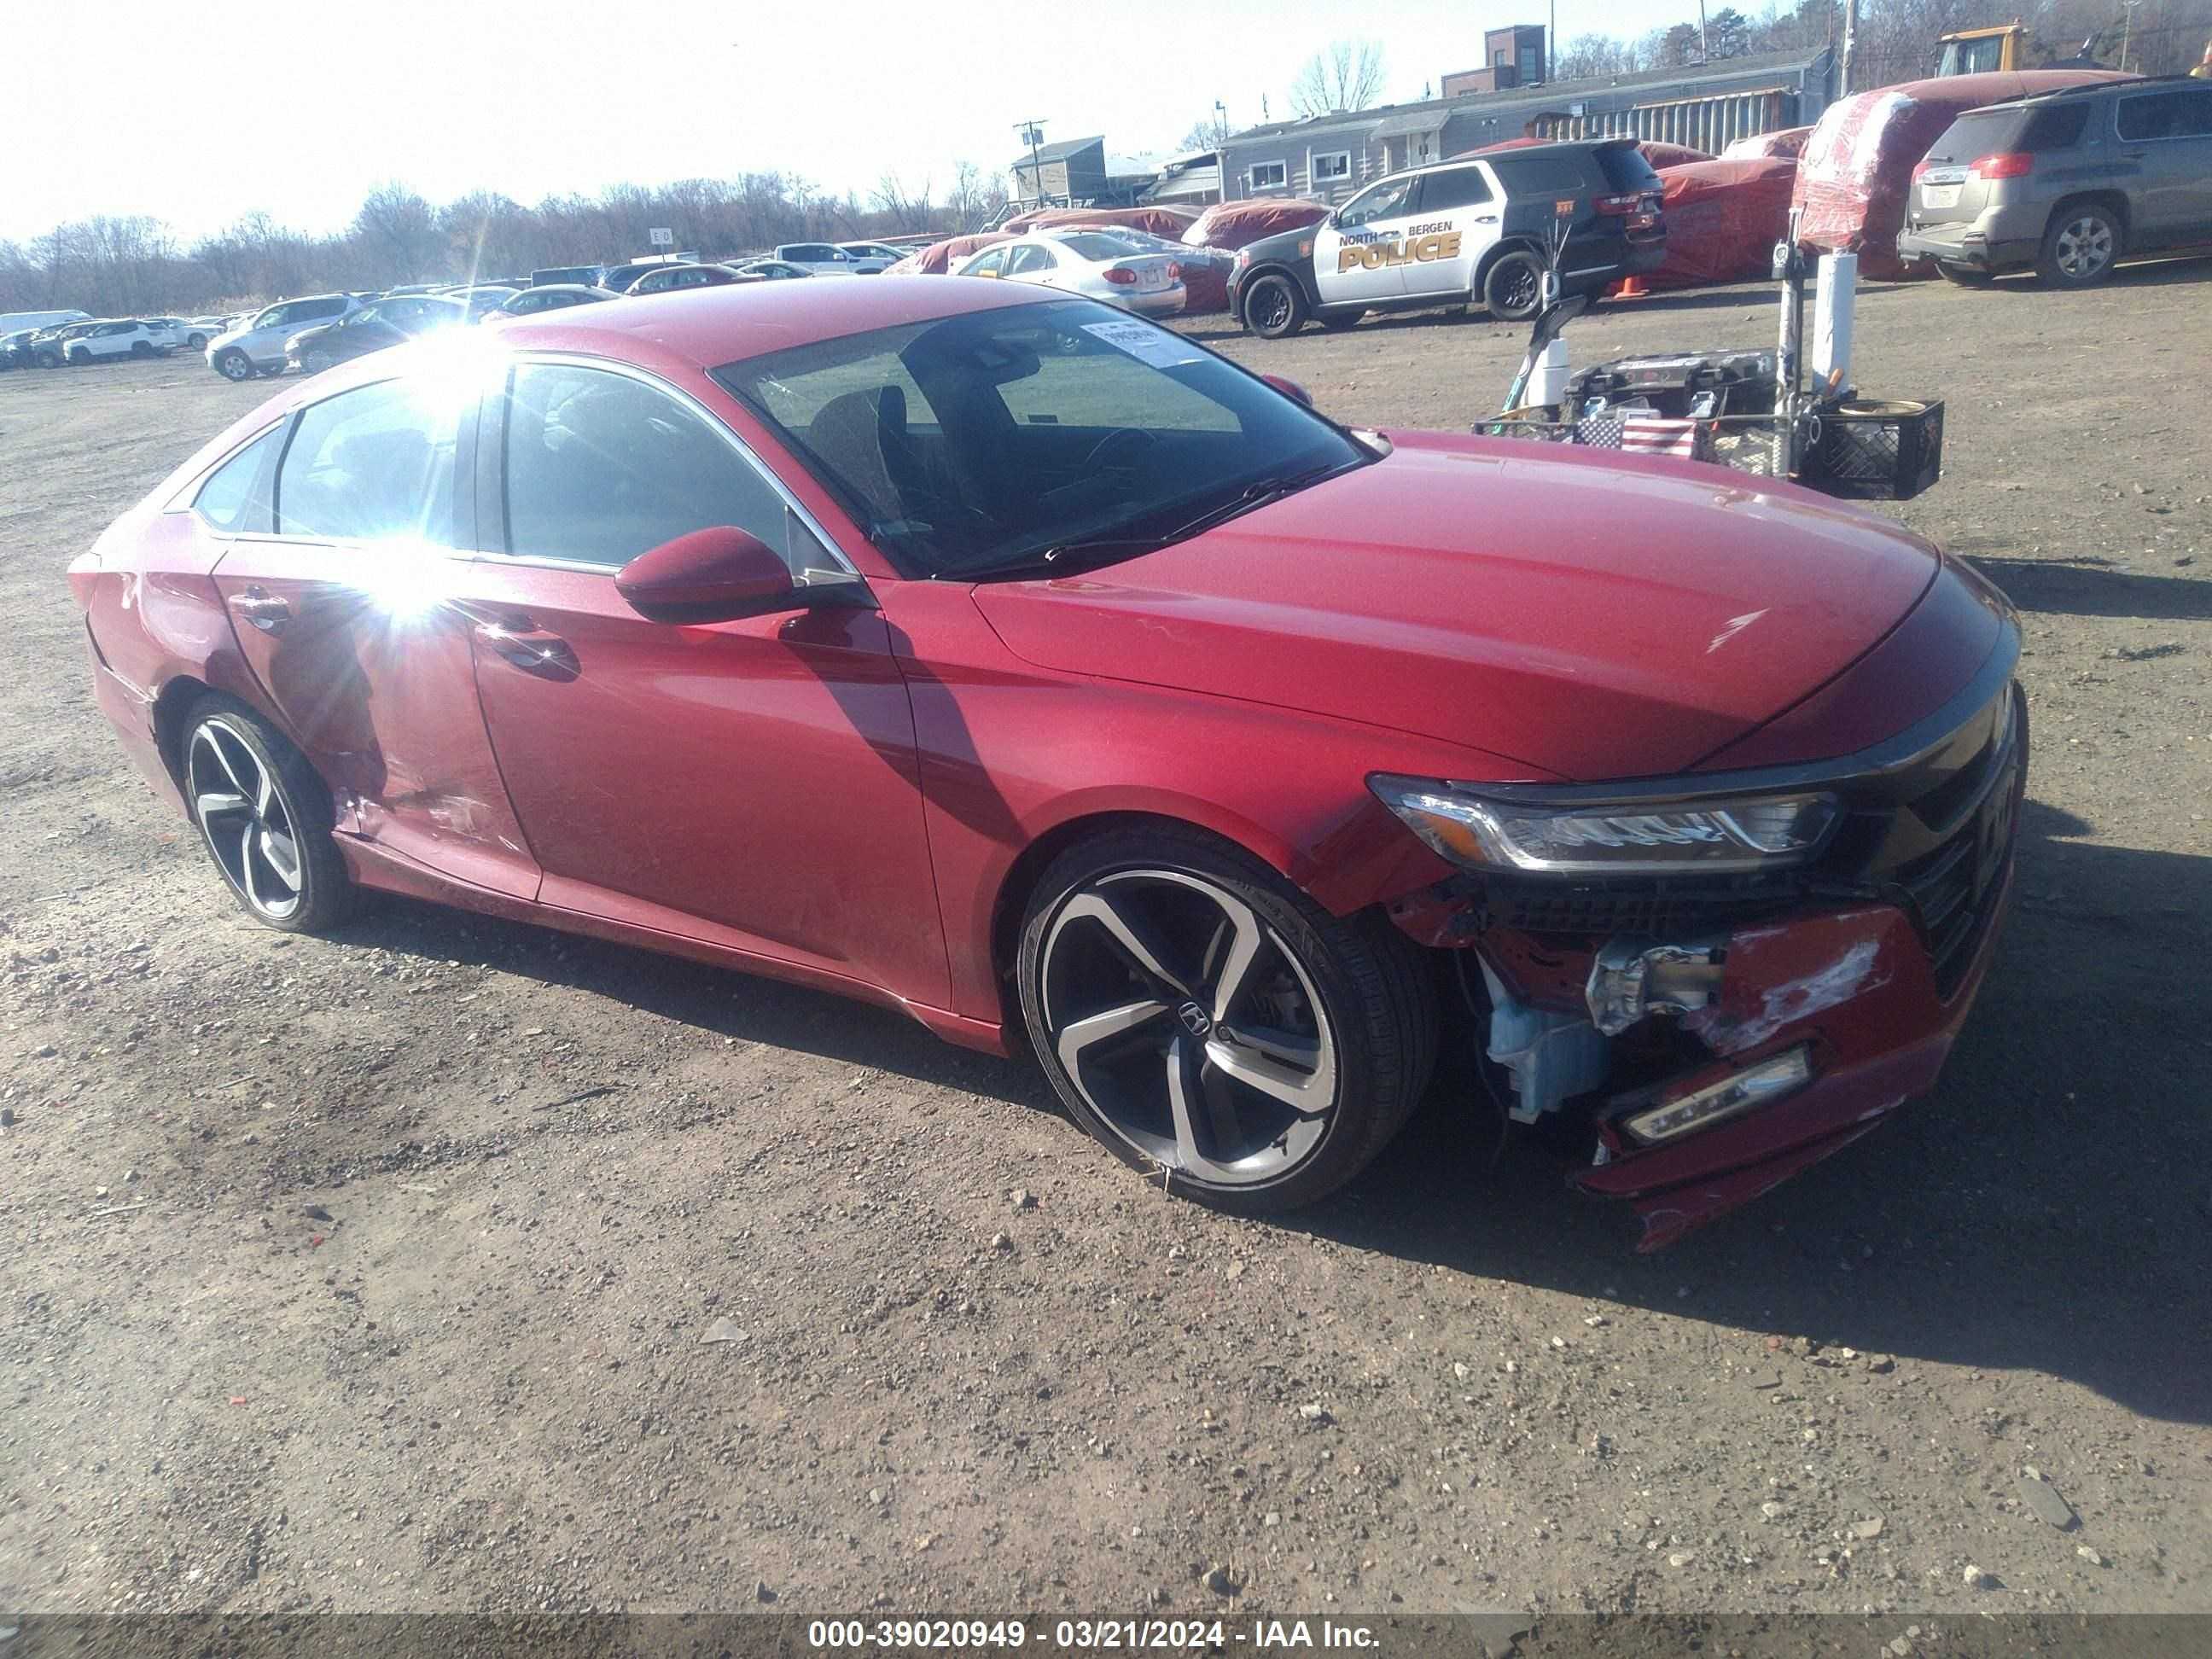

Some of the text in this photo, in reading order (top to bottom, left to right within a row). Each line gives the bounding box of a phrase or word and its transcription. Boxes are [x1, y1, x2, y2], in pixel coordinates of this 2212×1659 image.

[1340, 221, 1452, 246] NORTH BERGEN
[1338, 231, 1462, 273] POLICE
